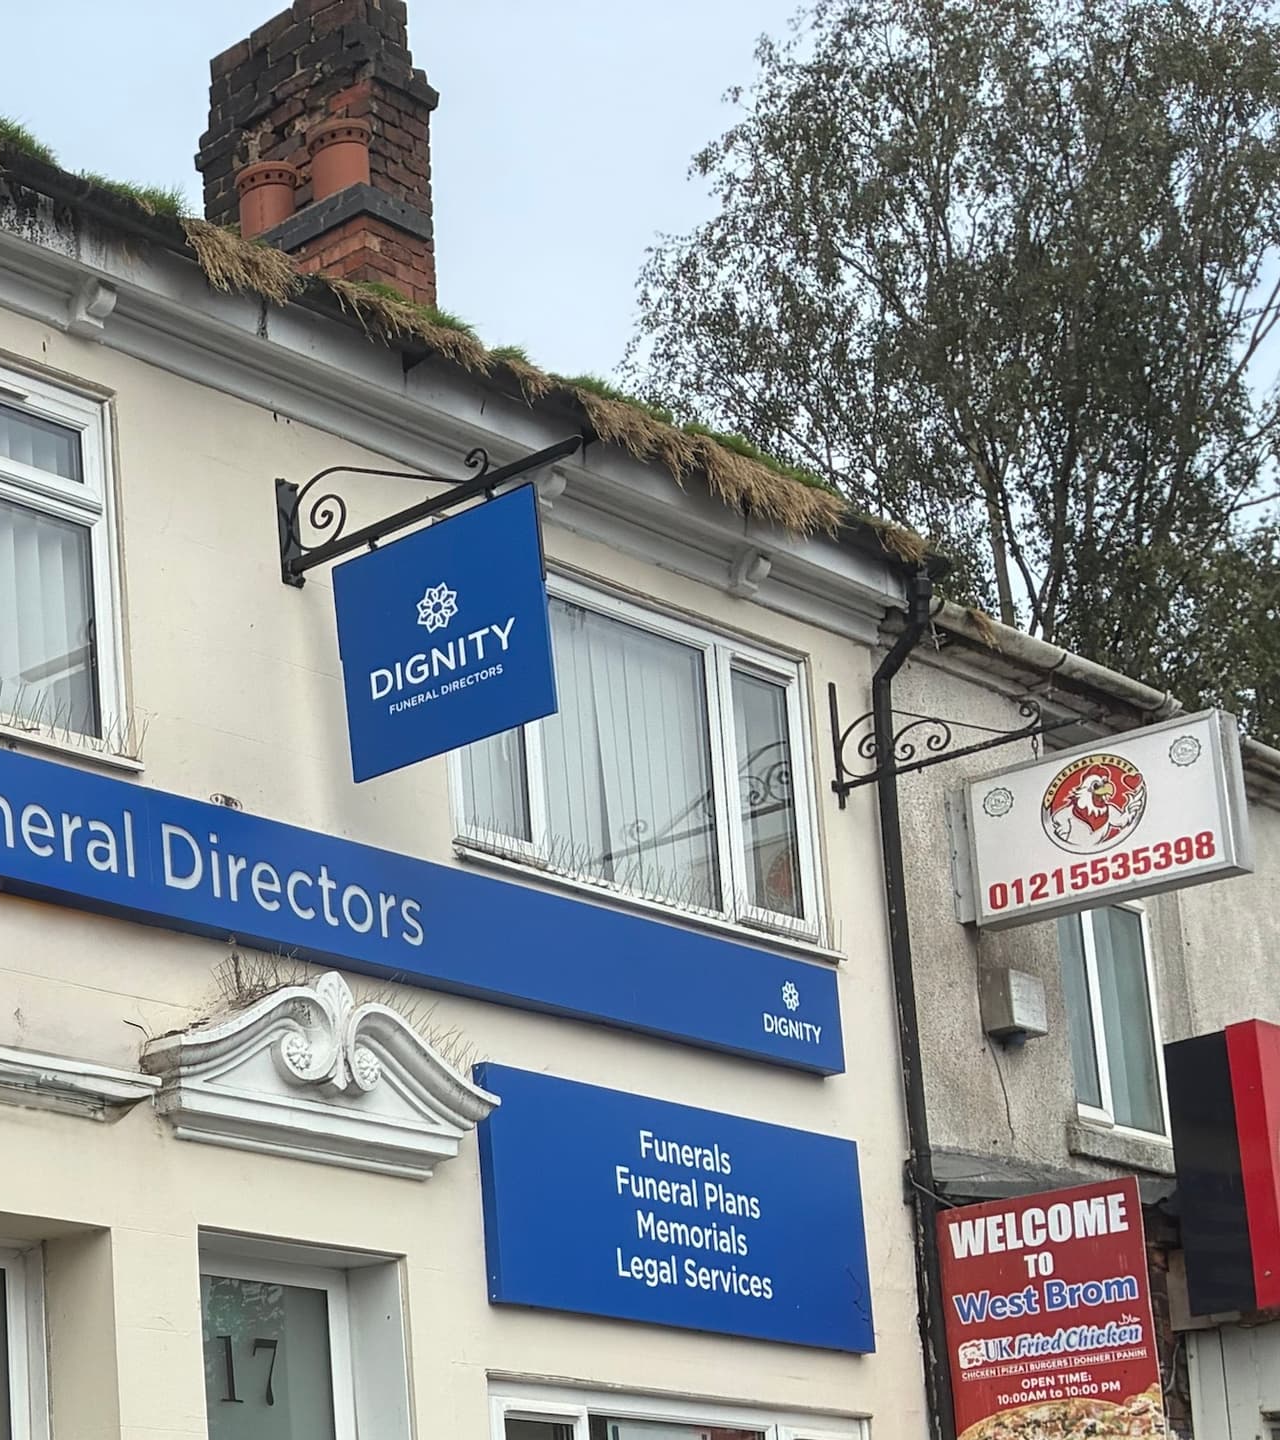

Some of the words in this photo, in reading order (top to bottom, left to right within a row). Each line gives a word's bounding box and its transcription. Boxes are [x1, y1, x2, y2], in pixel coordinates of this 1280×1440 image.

[369, 616, 516, 701] DIGNITY
[389, 689, 439, 715] FUNERAL
[441, 663, 504, 696] DIRECTORS
[1047, 757, 1094, 796] ORIGINAL
[1101, 756, 1134, 774] TASTE
[162, 821, 426, 949] Directors
[989, 830, 1216, 911] 01215535398
[763, 1012, 822, 1045] DIGNITY
[640, 1129, 732, 1176] Funerals
[615, 1165, 698, 1209] Funeral
[704, 1181, 761, 1220] Plans
[636, 1209, 749, 1257] Memorials
[949, 1192, 1129, 1260] WELCOME
[616, 1247, 678, 1288] Legal
[684, 1258, 774, 1300] Services
[1024, 1251, 1054, 1279] TO
[953, 1287, 1040, 1325] West
[1043, 1275, 1139, 1313] Brom
[961, 1369, 997, 1381] CHICKEN
[1001, 1366, 1025, 1376] PIZZA
[1029, 1359, 1069, 1372] BURGERS
[1073, 1354, 1111, 1366] DONNER
[1116, 1348, 1147, 1359] PANINI
[983, 1338, 1014, 1363] UK
[1015, 1329, 1065, 1359] Fried
[1065, 1321, 1143, 1353] Chicken
[216, 1335, 279, 1406] 17
[997, 1390, 1047, 1405] 10:00AM
[1049, 1388, 1063, 1398] to
[1065, 1383, 1098, 1396] 10:00
[1101, 1381, 1121, 1392] PM
[1021, 1376, 1055, 1390] OPEN
[1058, 1371, 1092, 1386] TIME:
